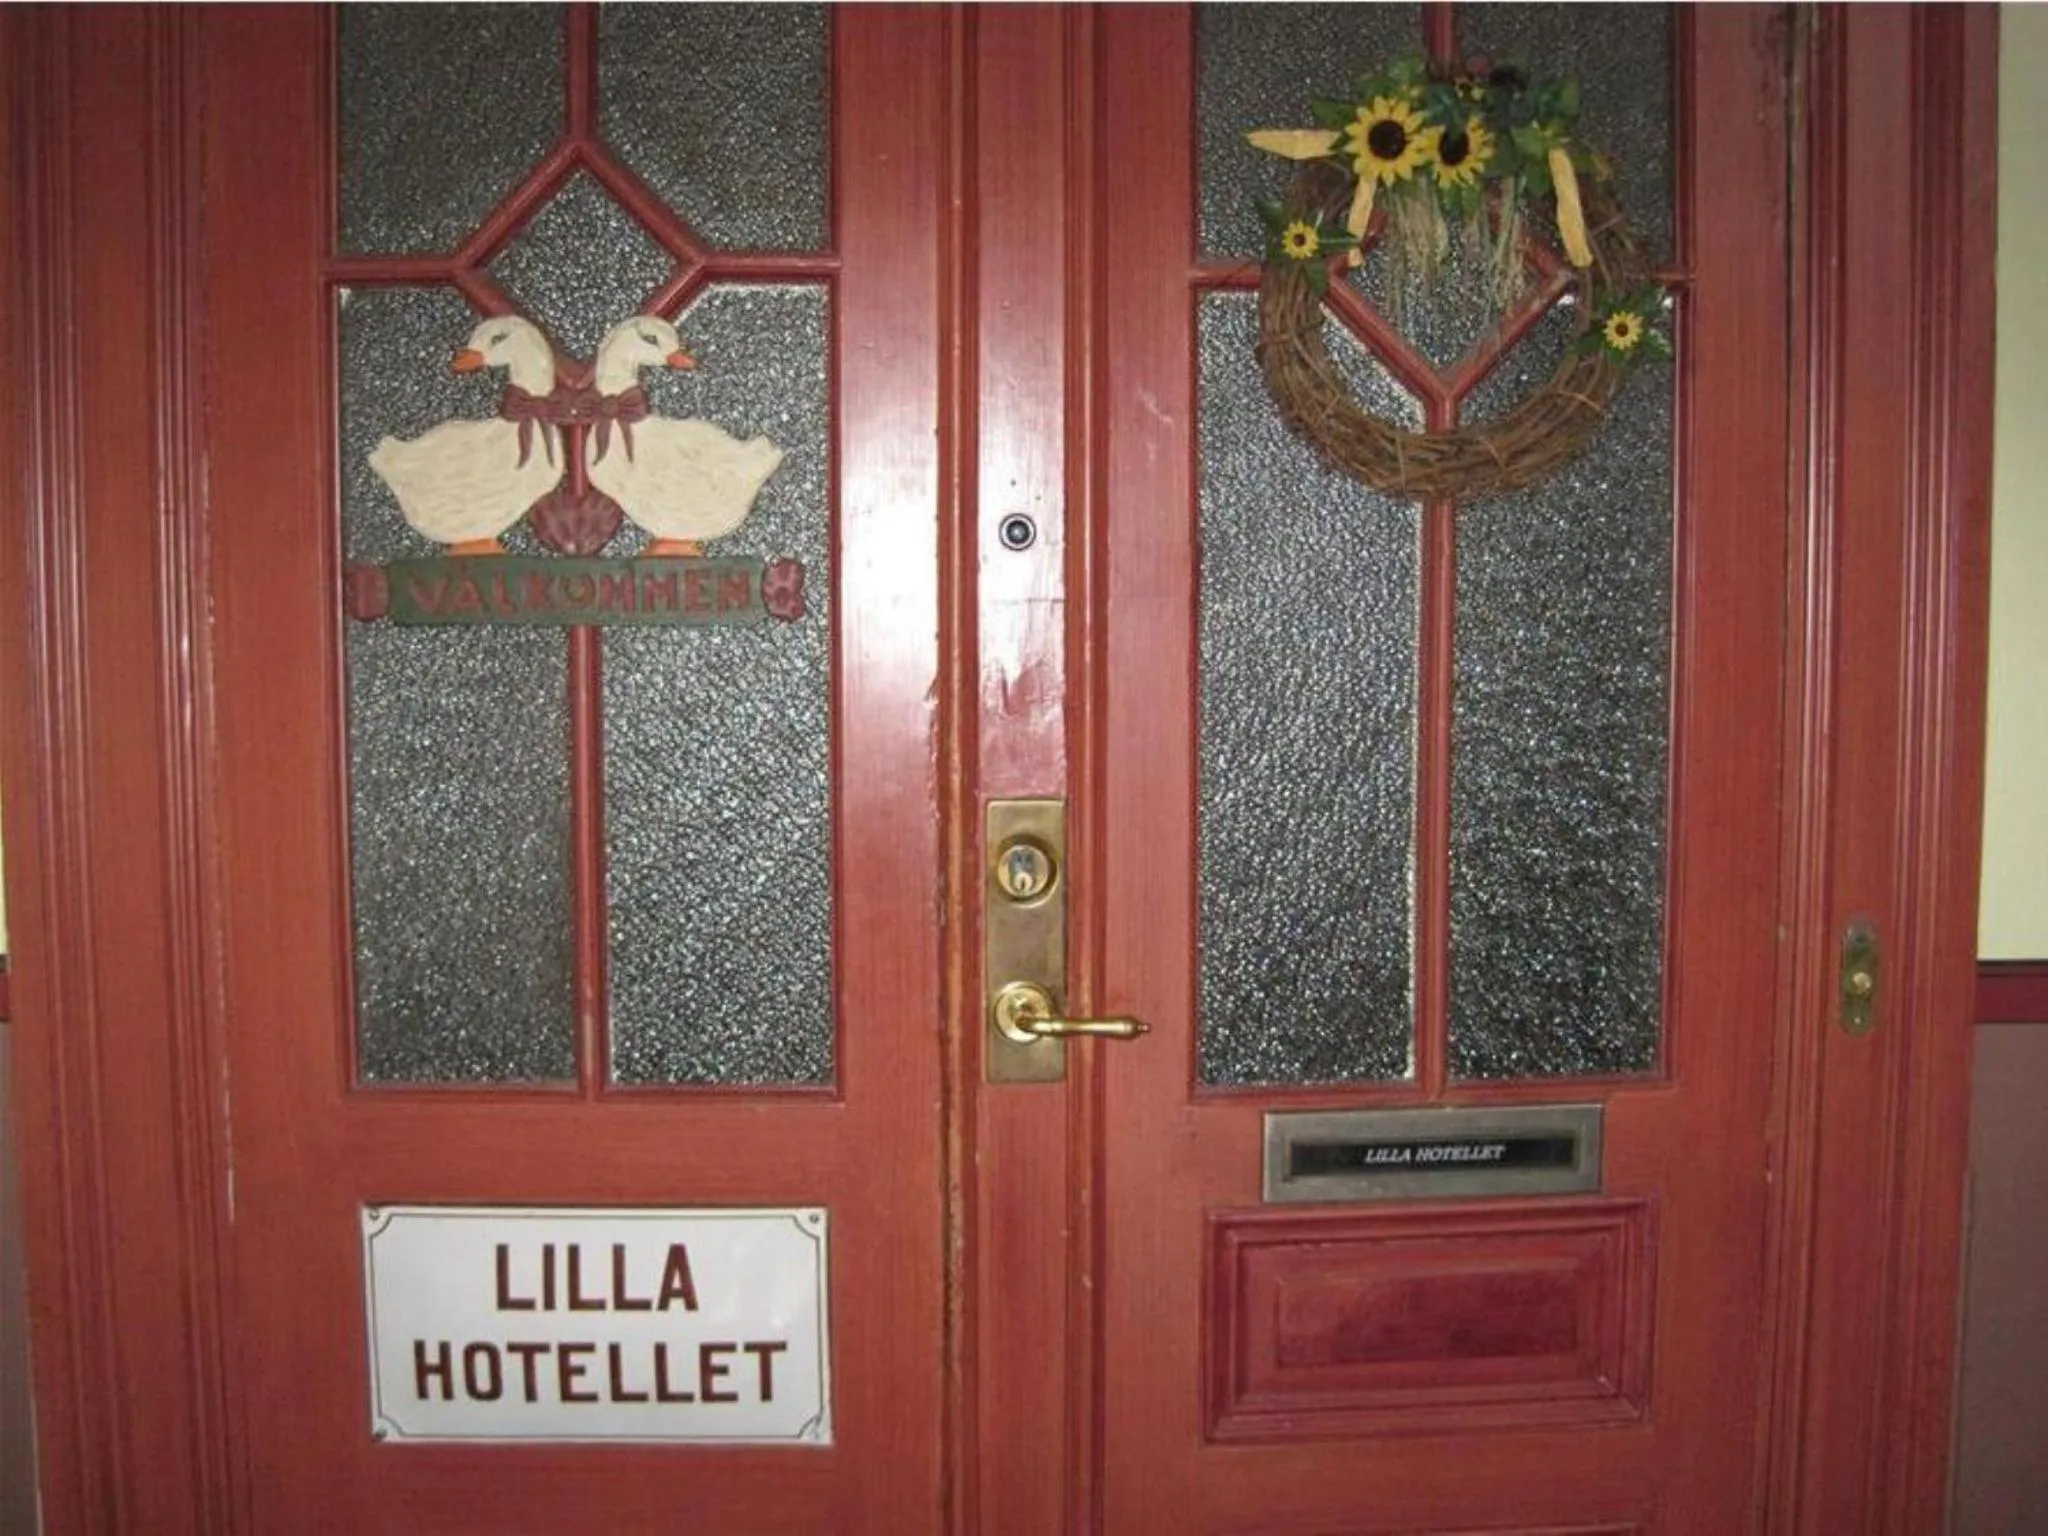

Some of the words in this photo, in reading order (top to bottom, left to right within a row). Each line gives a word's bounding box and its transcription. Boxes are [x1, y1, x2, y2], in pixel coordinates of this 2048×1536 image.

[1365, 1148, 1411, 1163] LILLA
[1415, 1145, 1505, 1161] HOTELLET
[495, 1243, 699, 1311] LILLA
[413, 1339, 787, 1403] HOTELLET
